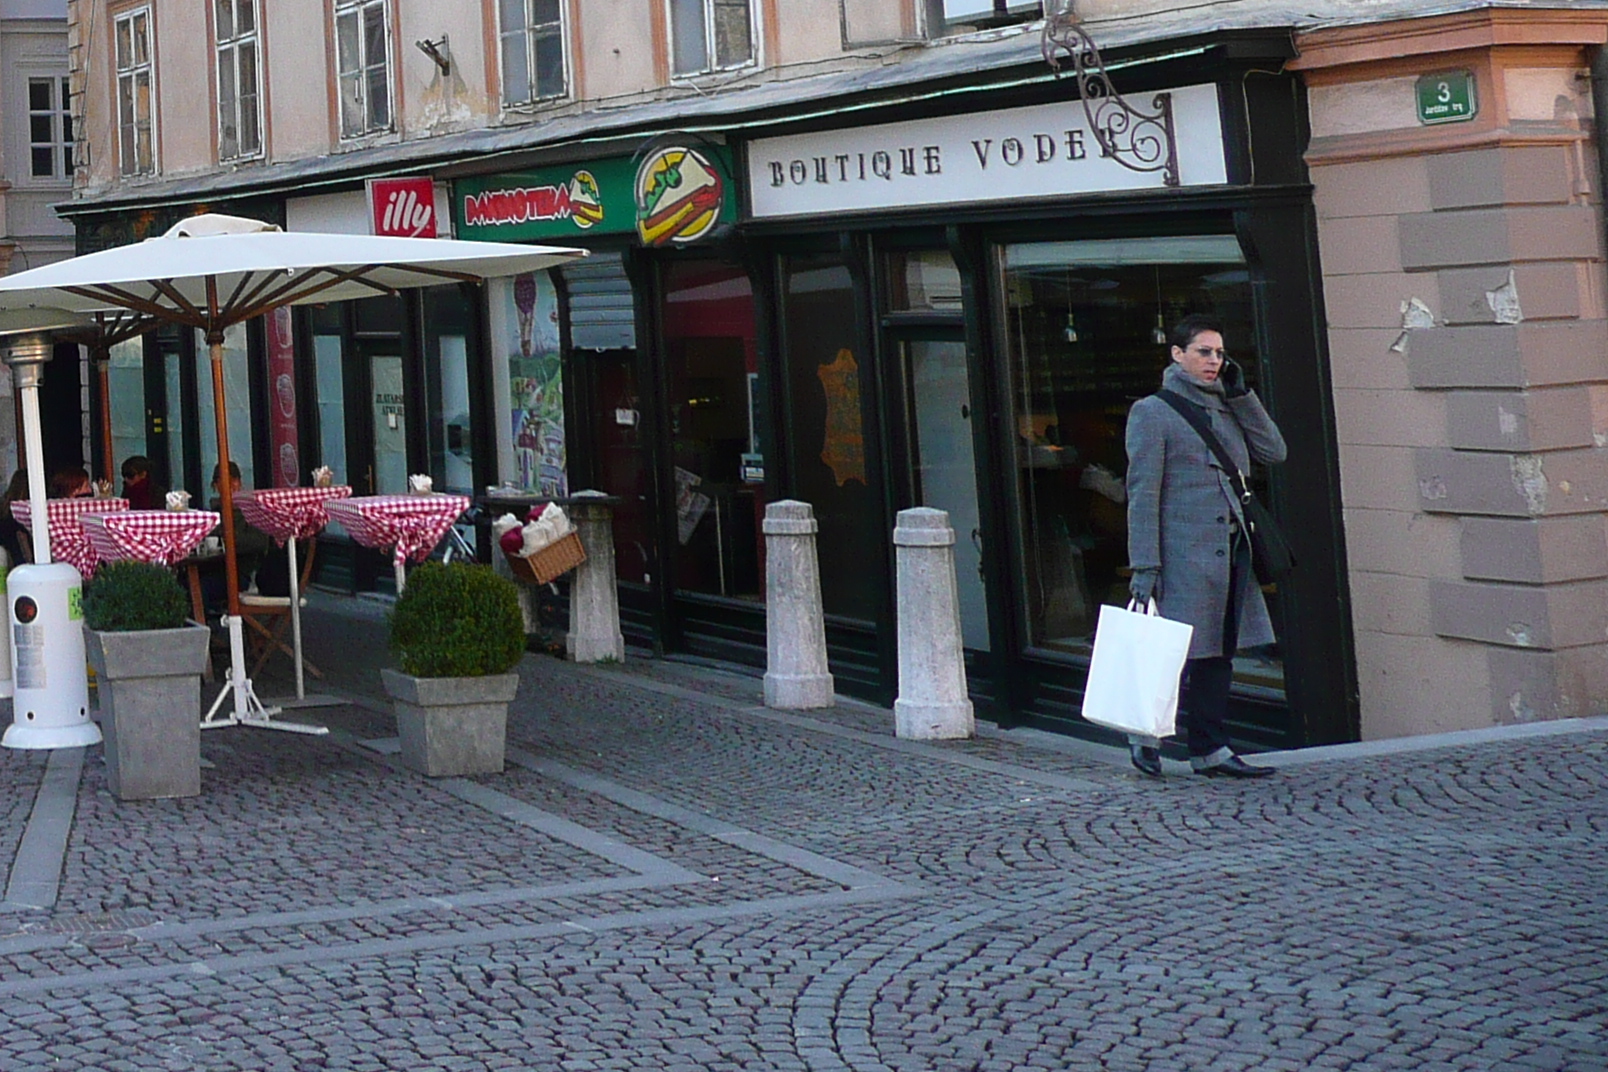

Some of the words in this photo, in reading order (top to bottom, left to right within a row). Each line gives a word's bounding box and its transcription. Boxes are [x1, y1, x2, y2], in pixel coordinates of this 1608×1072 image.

[1437, 81, 1451, 103] 3
[767, 145, 943, 188] BOUTIQUE
[382, 189, 433, 239] illy
